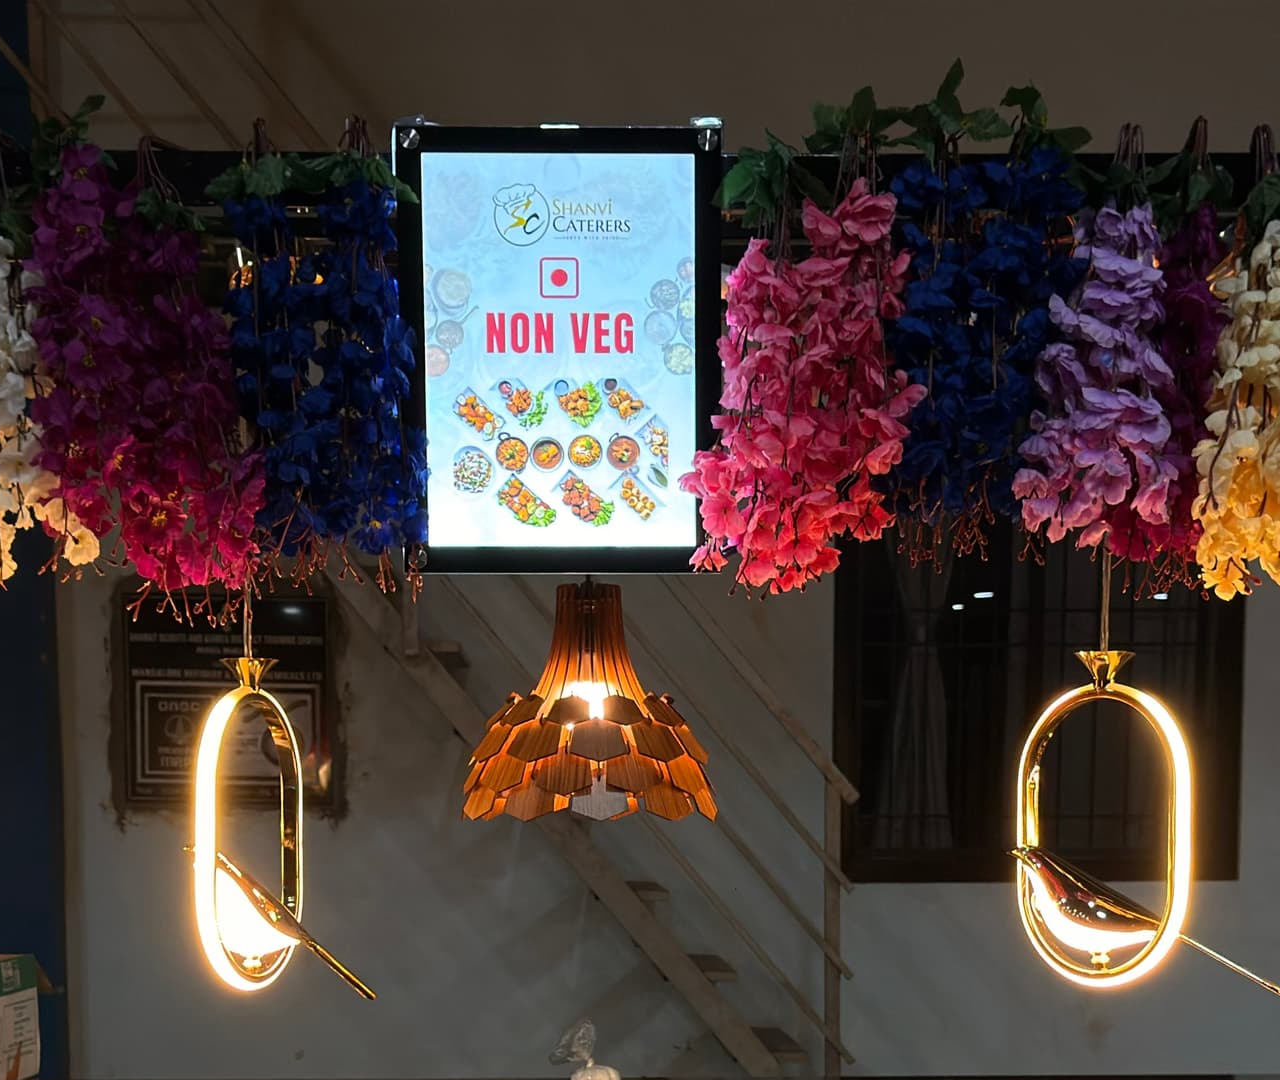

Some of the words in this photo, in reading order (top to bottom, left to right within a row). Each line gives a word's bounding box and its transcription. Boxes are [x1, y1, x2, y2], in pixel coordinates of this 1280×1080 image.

[552, 215, 631, 233] CATERERS
[486, 312, 554, 354] NON
[570, 312, 634, 354] VEG
